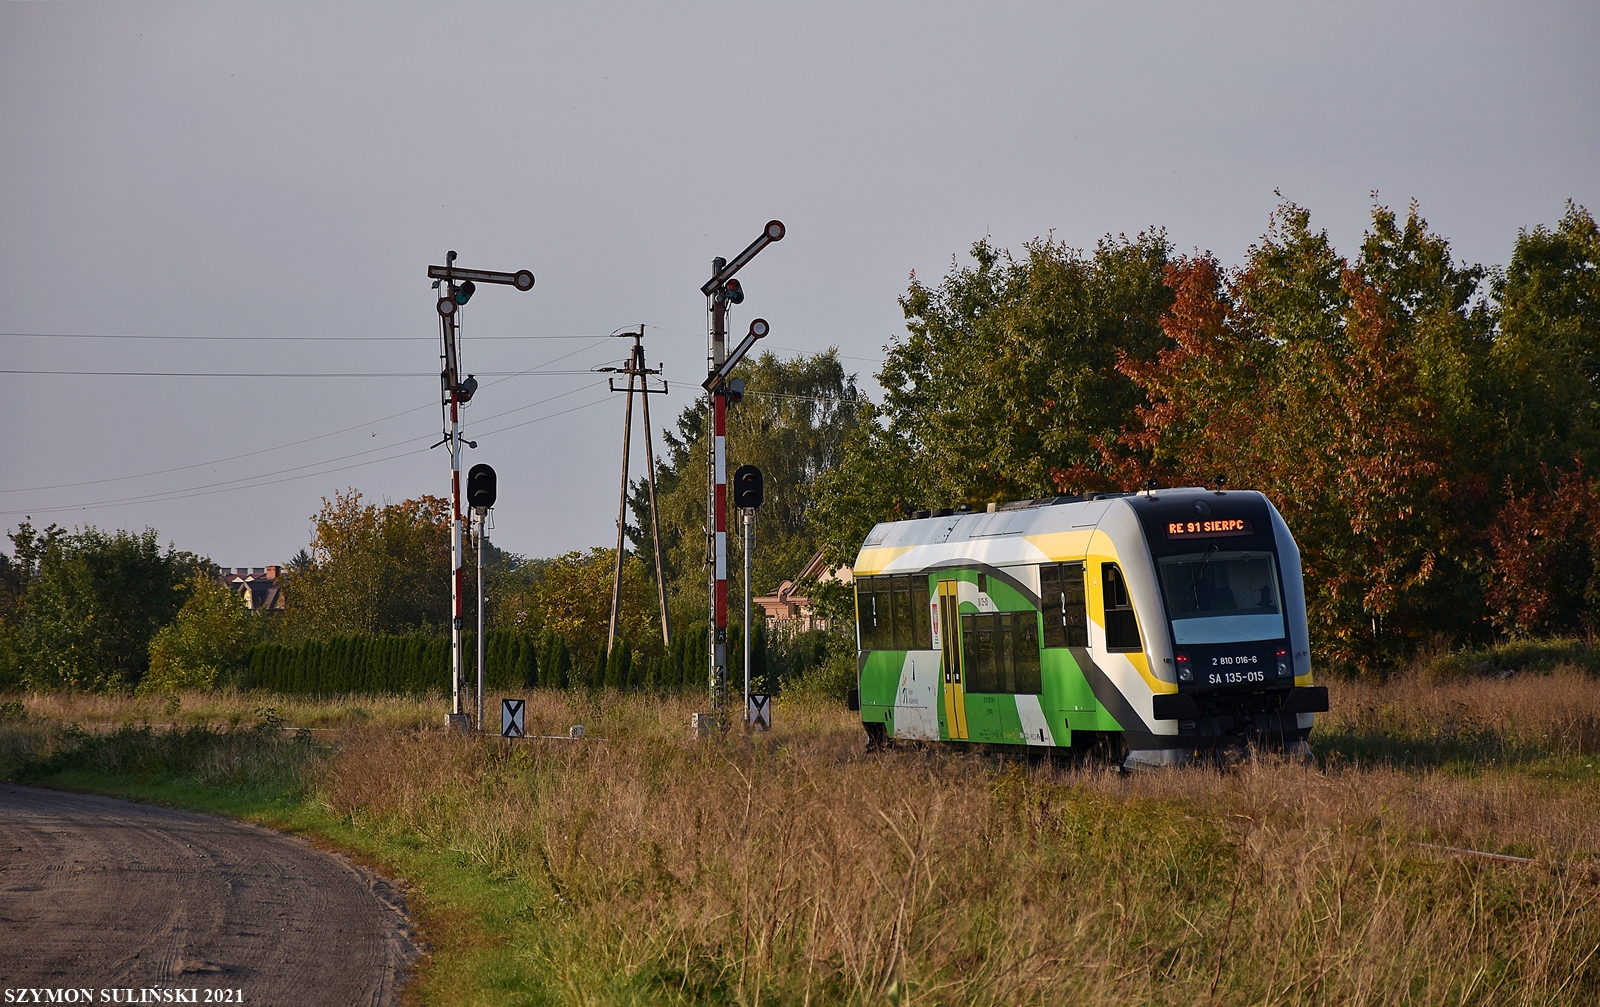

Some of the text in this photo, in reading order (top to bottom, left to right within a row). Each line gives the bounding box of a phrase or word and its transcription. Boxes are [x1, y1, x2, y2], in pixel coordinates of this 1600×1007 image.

[1169, 519, 1244, 534] RE 91 SIERPC
[1212, 655, 1258, 666] 2 810 016-6
[1209, 671, 1264, 684] SA 135-015
